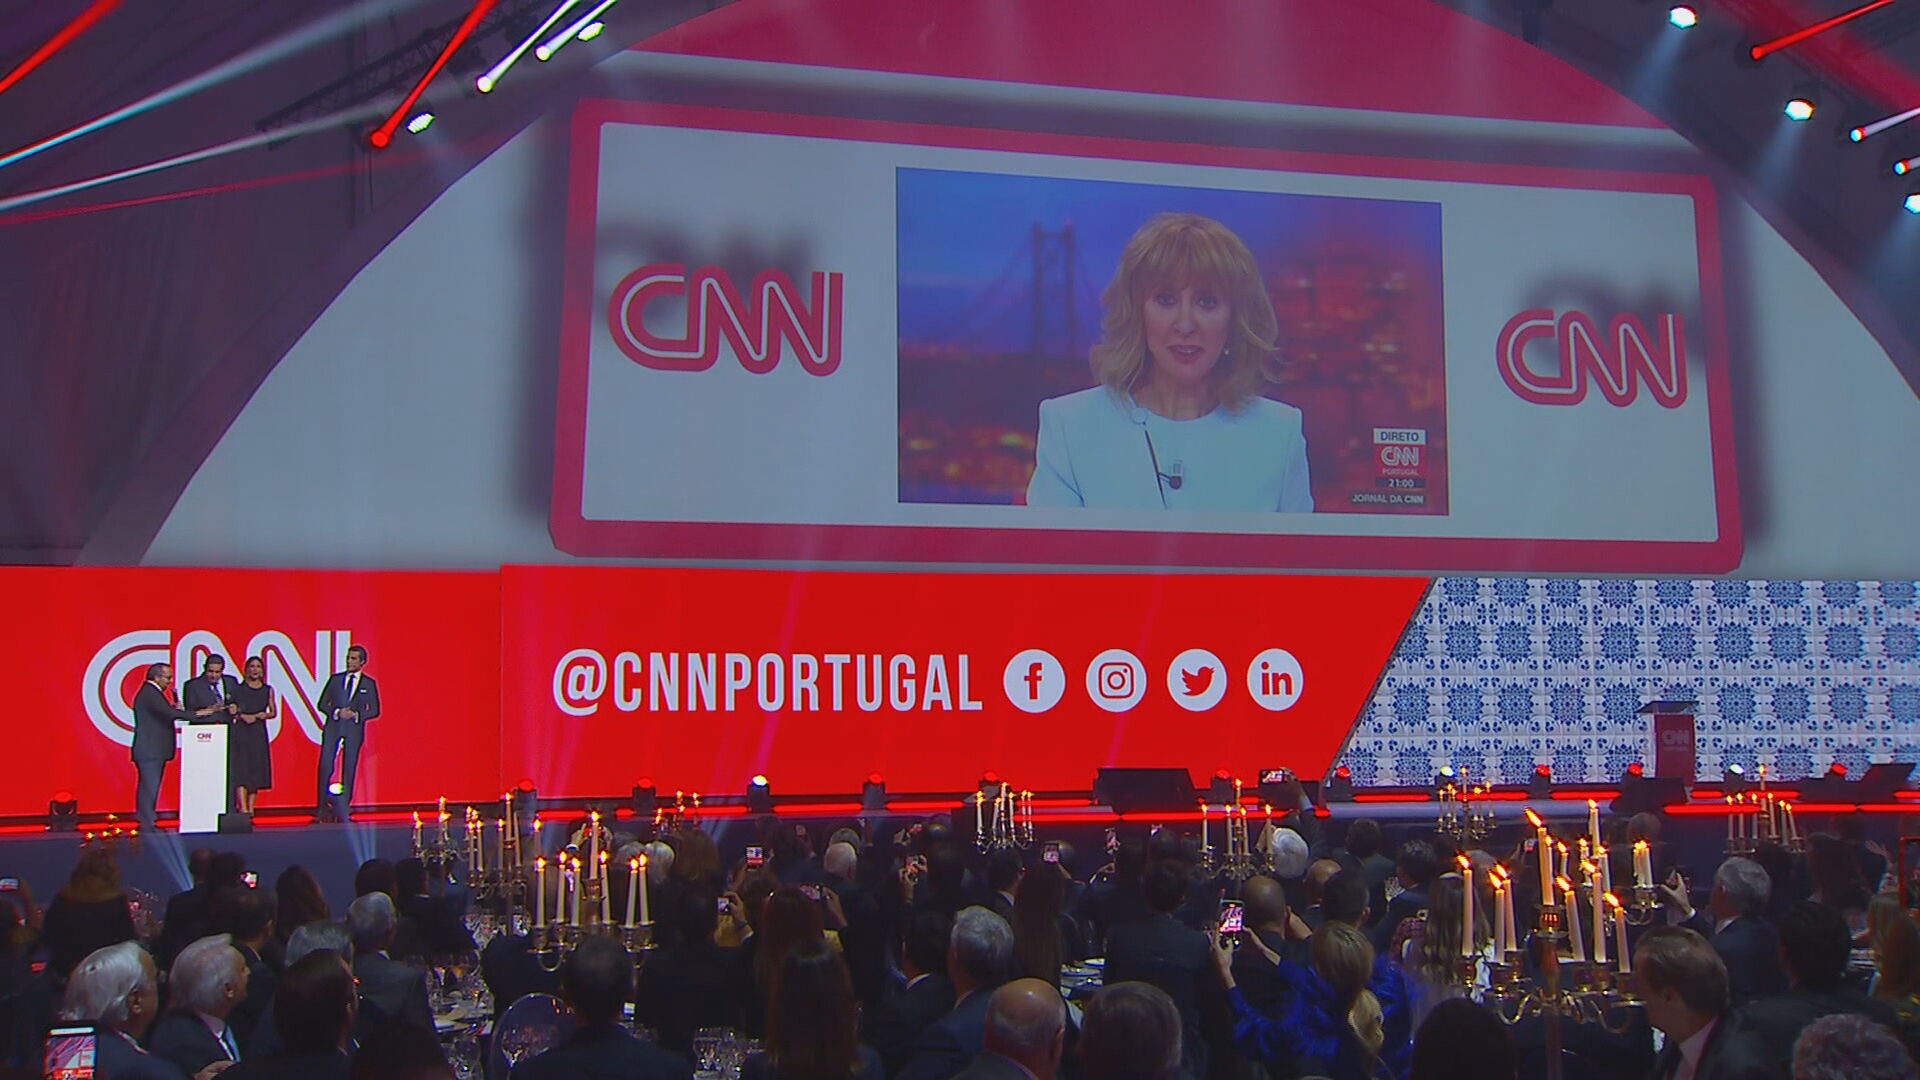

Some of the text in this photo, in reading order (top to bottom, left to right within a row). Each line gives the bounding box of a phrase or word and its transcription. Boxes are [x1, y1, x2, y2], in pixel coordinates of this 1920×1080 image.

[607, 263, 843, 377] CNN
[1496, 308, 1688, 409] CNN
[1380, 431, 1420, 442] DIRETO
[1381, 446, 1419, 466] CNN
[1388, 479, 1414, 488] 21:00
[1352, 494, 1424, 504] JORNAL DA CNN
[553, 648, 983, 716] @CNNPORTUGAL
